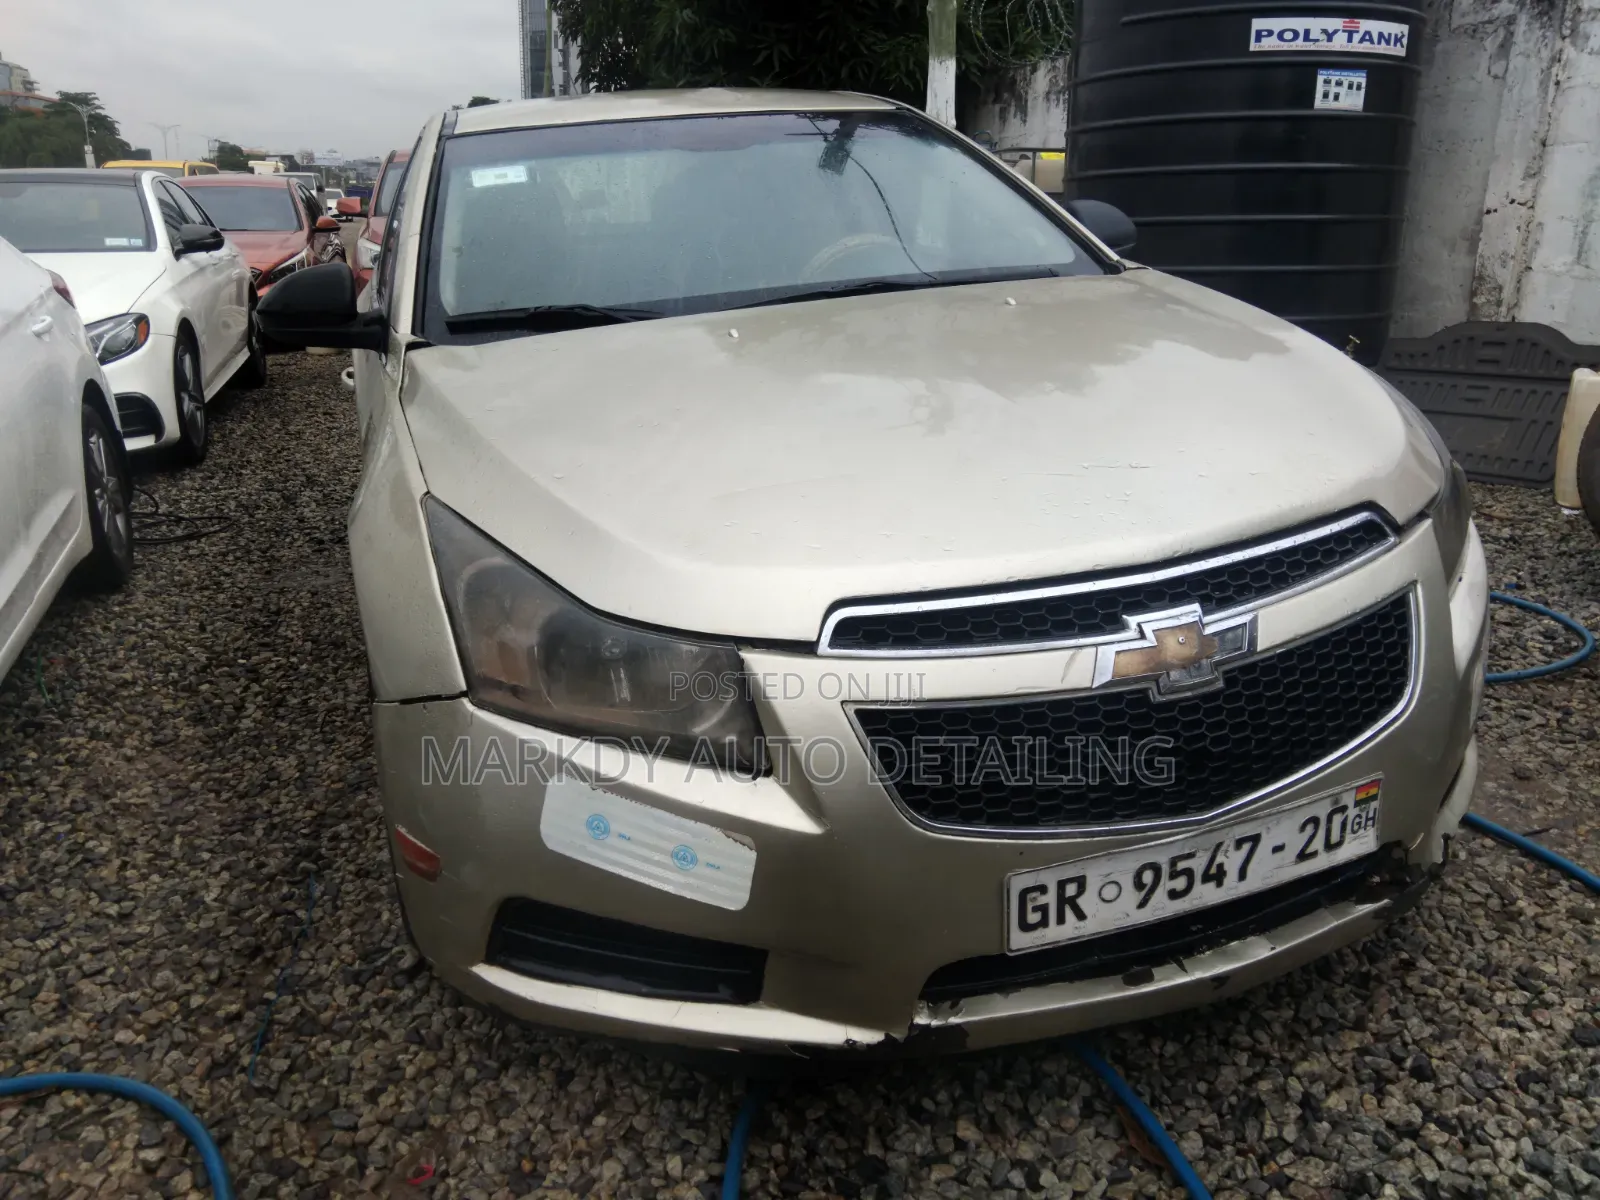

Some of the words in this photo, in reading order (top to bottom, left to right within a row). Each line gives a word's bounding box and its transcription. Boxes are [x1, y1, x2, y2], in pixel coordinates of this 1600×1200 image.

[1254, 28, 1405, 48] POLYTANK
[1017, 874, 1087, 933] GR
[1350, 806, 1378, 836] GH
